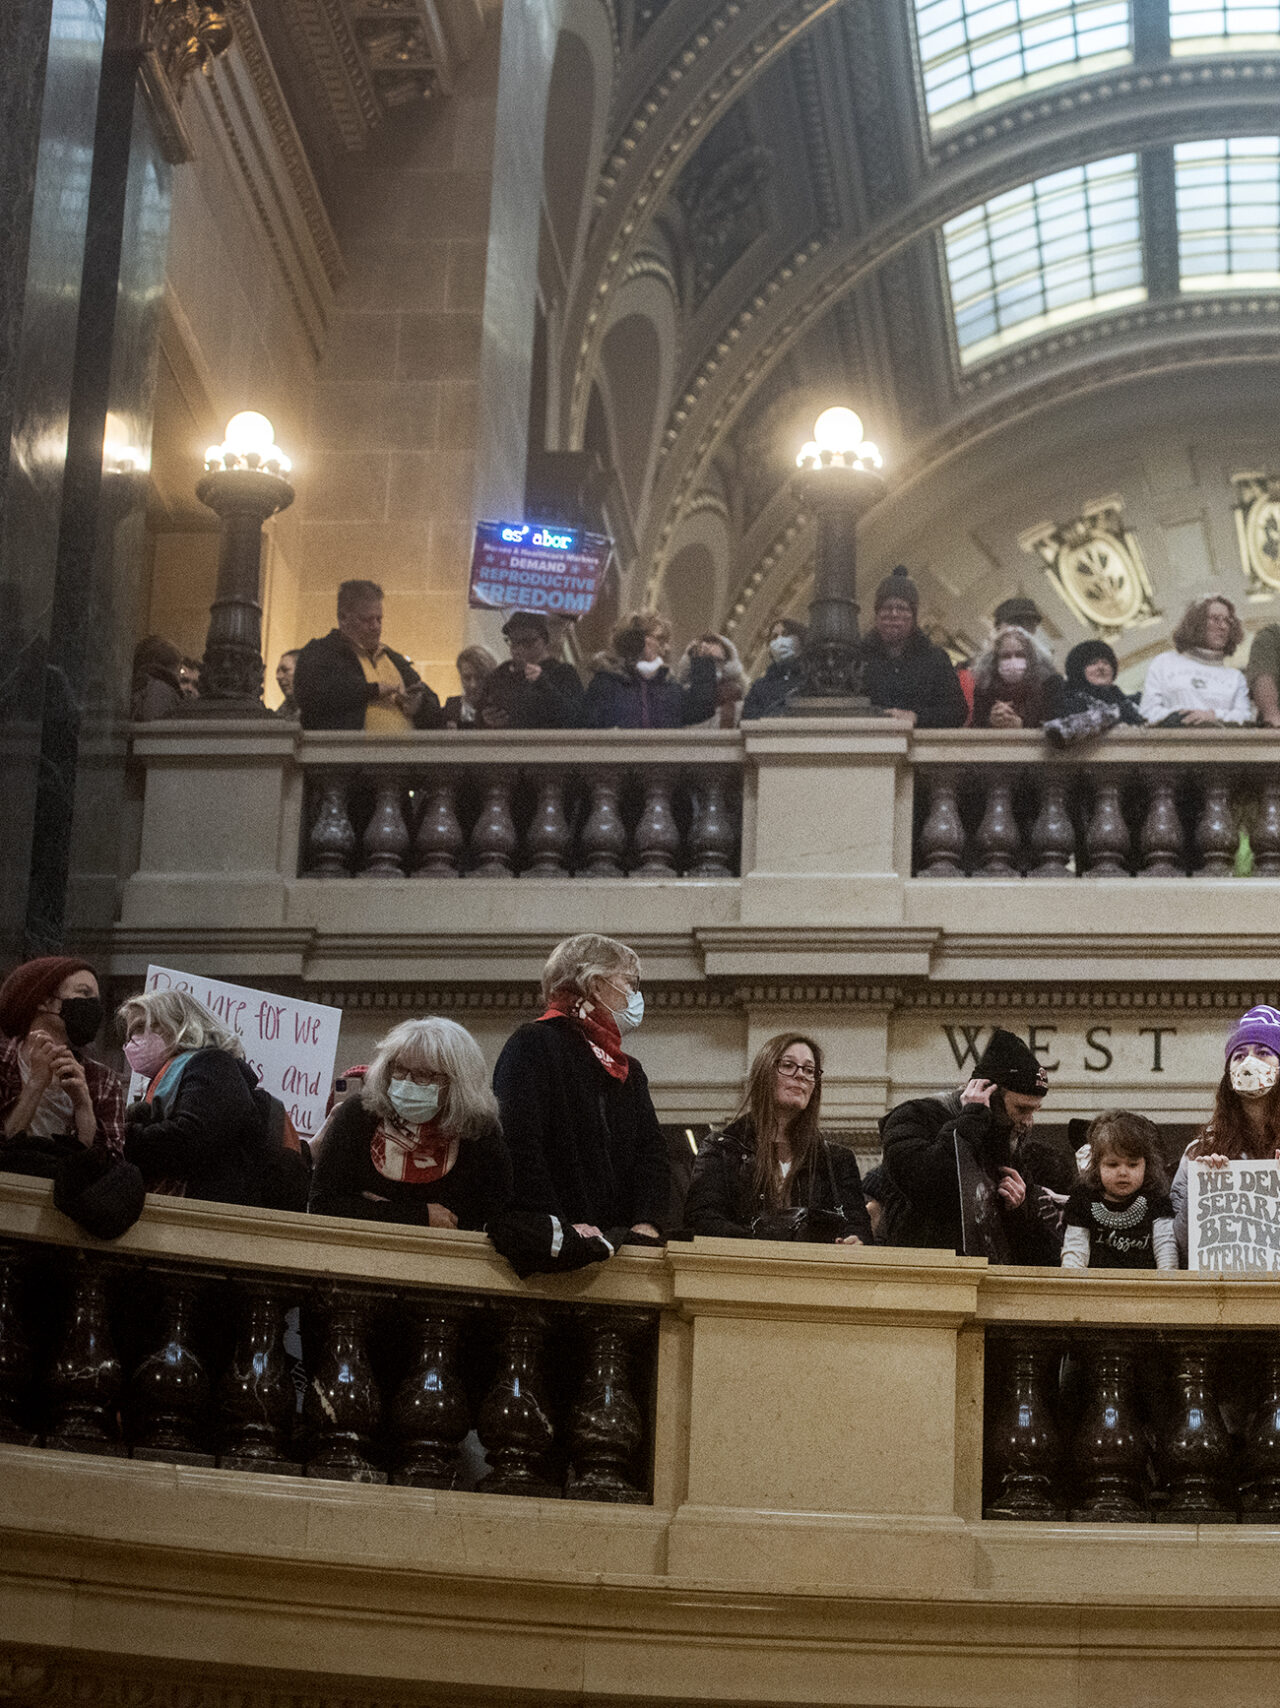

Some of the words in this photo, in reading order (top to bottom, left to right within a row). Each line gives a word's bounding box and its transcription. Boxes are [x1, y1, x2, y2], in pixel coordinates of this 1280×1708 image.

[532, 529, 573, 549] abor
[479, 565, 596, 592] REPRODUCTIVE
[510, 556, 567, 574] DEMAND
[475, 581, 594, 611] FREEDOM!
[254, 1000, 287, 1041] for
[294, 1012, 321, 1045] we
[943, 1025, 1178, 1072] WEST
[281, 1065, 321, 1096] and
[1197, 1170, 1234, 1196] WE
[1197, 1244, 1268, 1271] UTERUS
